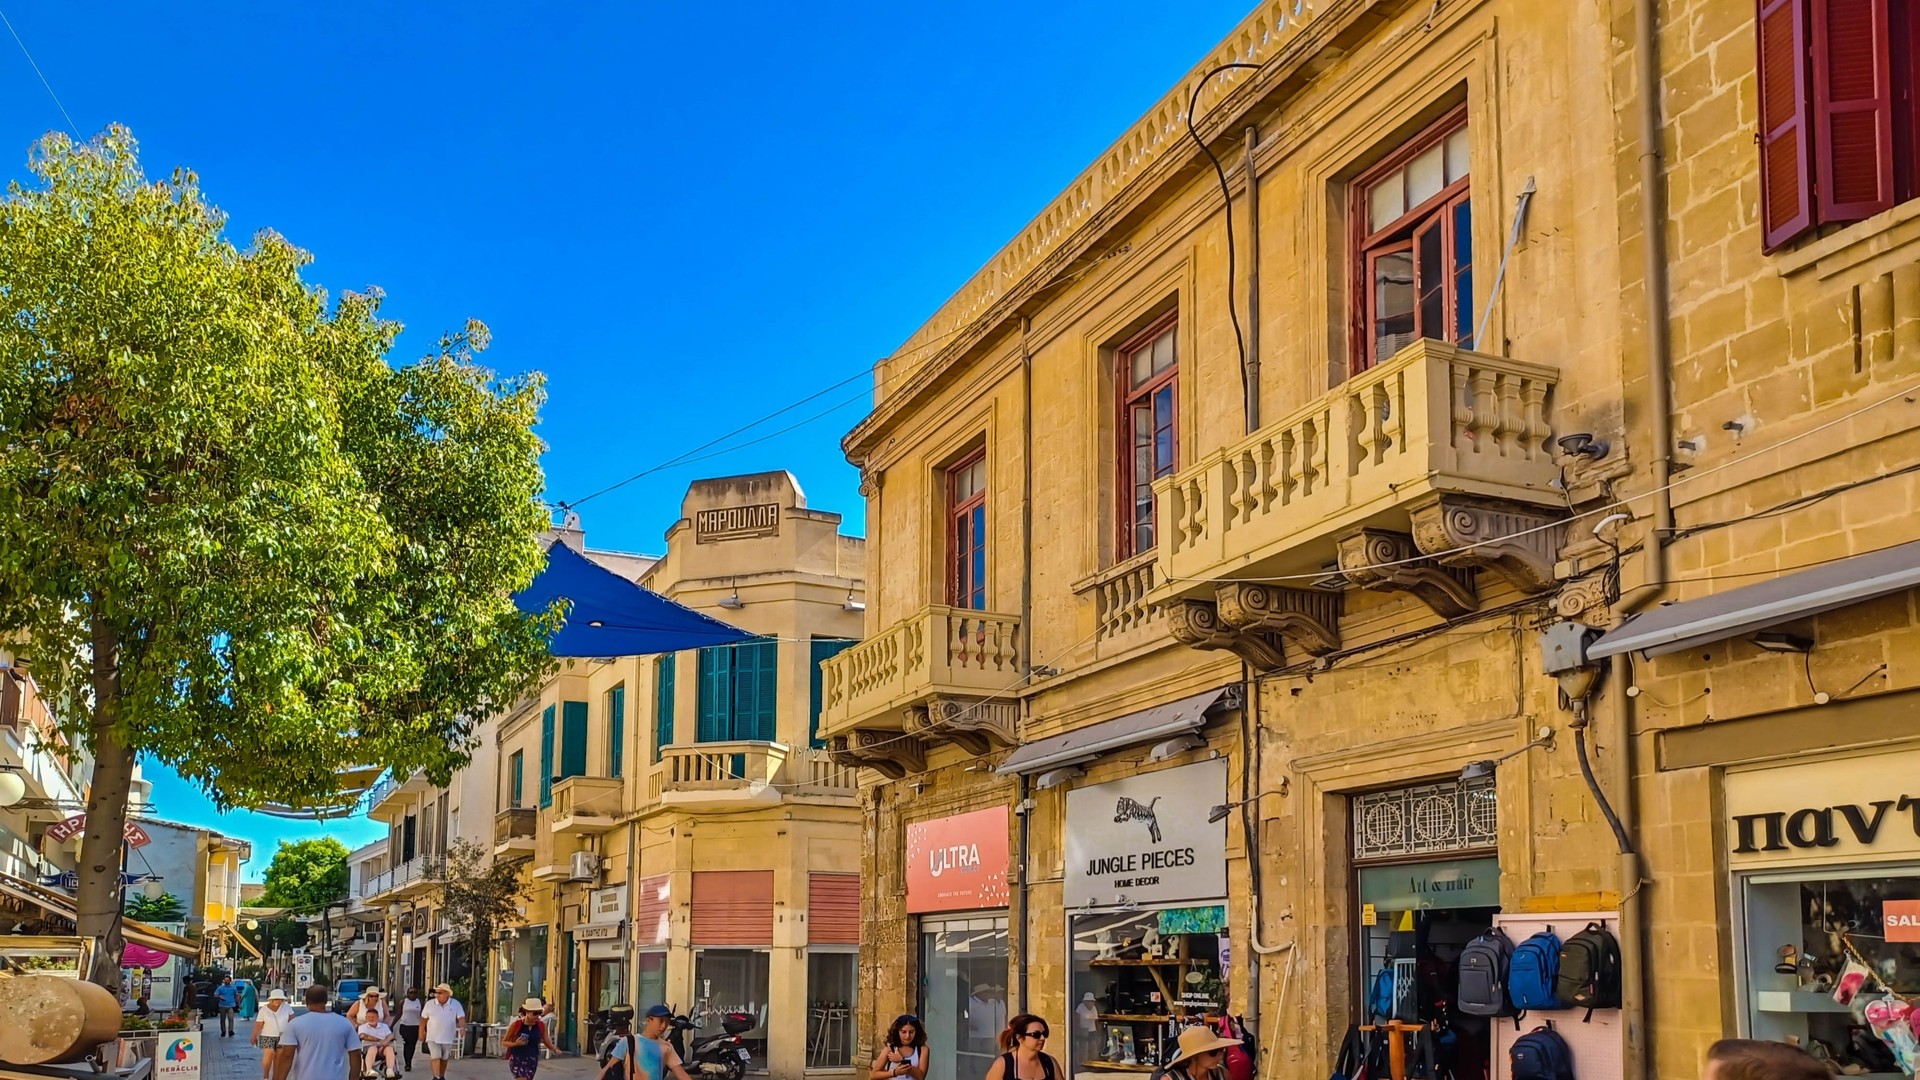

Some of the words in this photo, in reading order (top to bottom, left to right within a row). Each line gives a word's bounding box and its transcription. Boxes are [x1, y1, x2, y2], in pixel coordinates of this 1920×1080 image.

[930, 843, 980, 877] ULTRA
[1086, 854, 1137, 876] JUNGLE
[1141, 847, 1195, 870] PIECES
[1114, 878, 1134, 888] HOME
[1135, 876, 1160, 887] DECOR
[1410, 877, 1427, 894] Art
[1432, 880, 1441, 892] &
[1886, 914, 1920, 927] SAL
